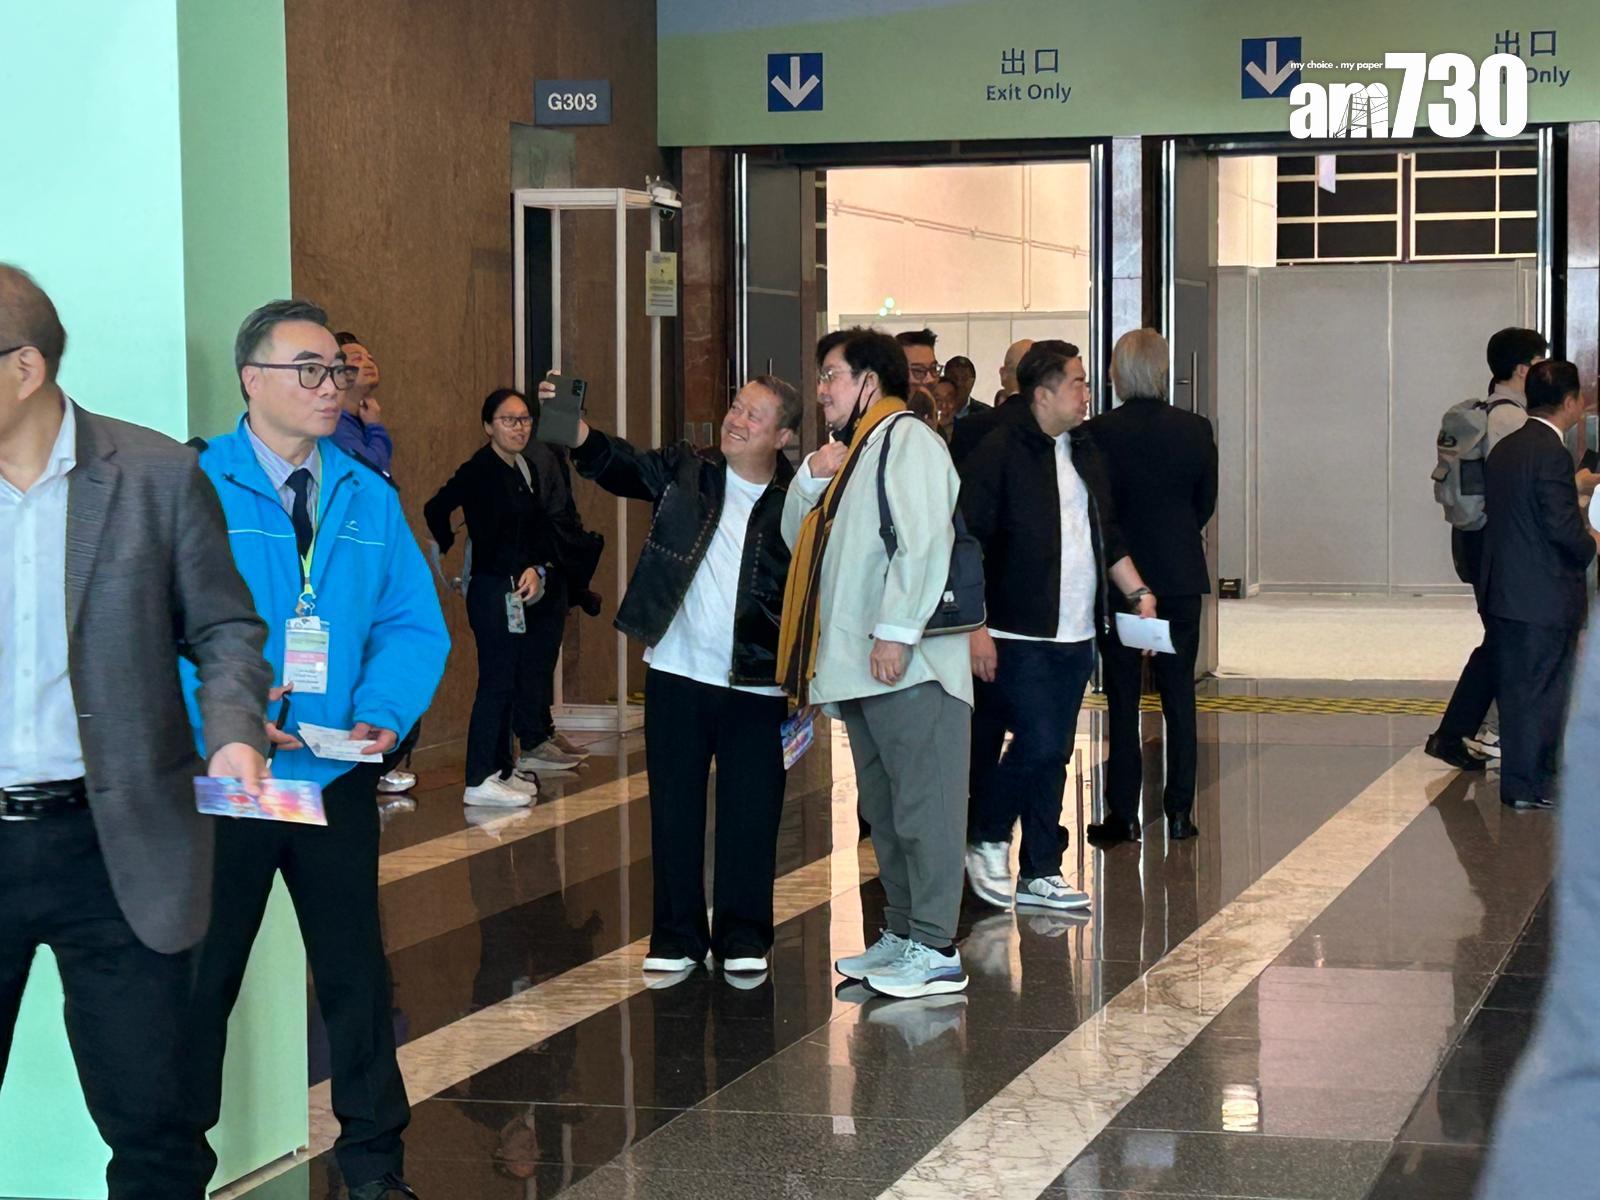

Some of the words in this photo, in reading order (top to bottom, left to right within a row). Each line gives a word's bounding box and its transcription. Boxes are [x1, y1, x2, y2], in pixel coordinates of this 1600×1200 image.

[1495, 30, 1556, 57] 出口
[1001, 47, 1058, 75] 出口
[548, 92, 597, 111] G303
[986, 84, 1021, 101] Exit
[1027, 82, 1071, 103] Only
